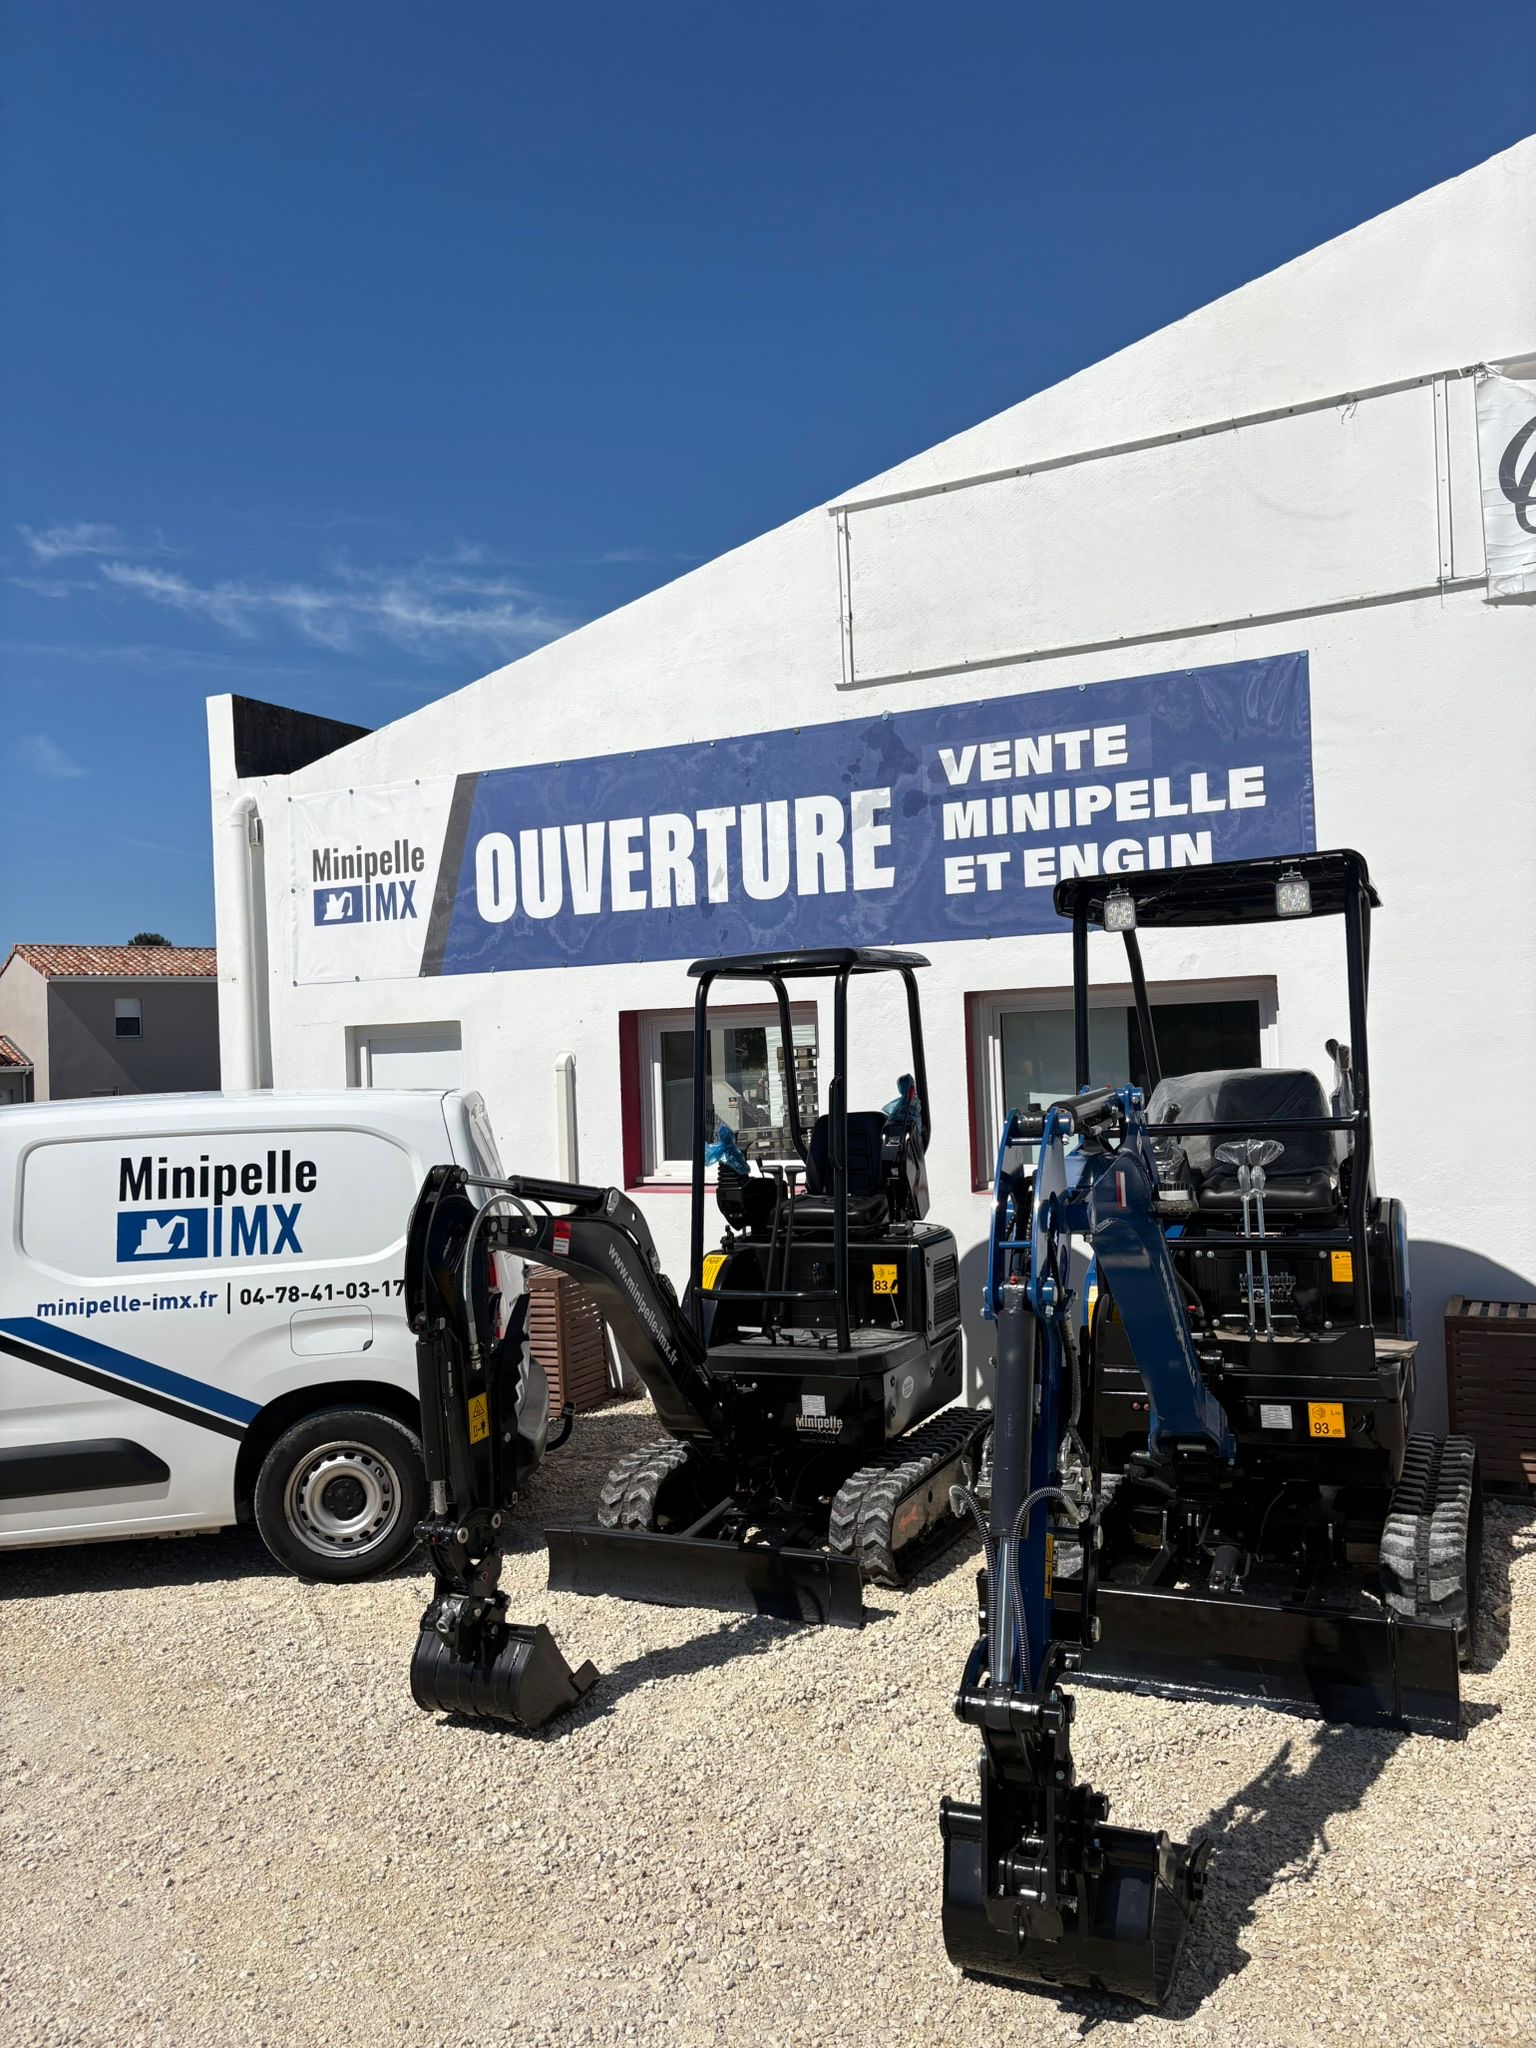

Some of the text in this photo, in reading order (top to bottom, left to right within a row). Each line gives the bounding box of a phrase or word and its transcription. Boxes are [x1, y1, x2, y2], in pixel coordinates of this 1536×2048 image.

[938, 724, 1128, 785] VENTE
[943, 766, 1266, 841] MINIPELLE
[312, 839, 425, 884] Minipelle
[475, 787, 896, 923] OUVERTURE
[944, 830, 1213, 895] ET ENGIN
[365, 880, 418, 922] IMX
[119, 1149, 317, 1206] Minipelle
[213, 1203, 304, 1257] IMX
[36, 1279, 406, 1318] minipelle-imx.fr 04-78-41-03-17
[608, 1243, 678, 1366] www.minipelle-imx.fr
[874, 1280, 888, 1291] 83
[1314, 1422, 1329, 1434] 93
